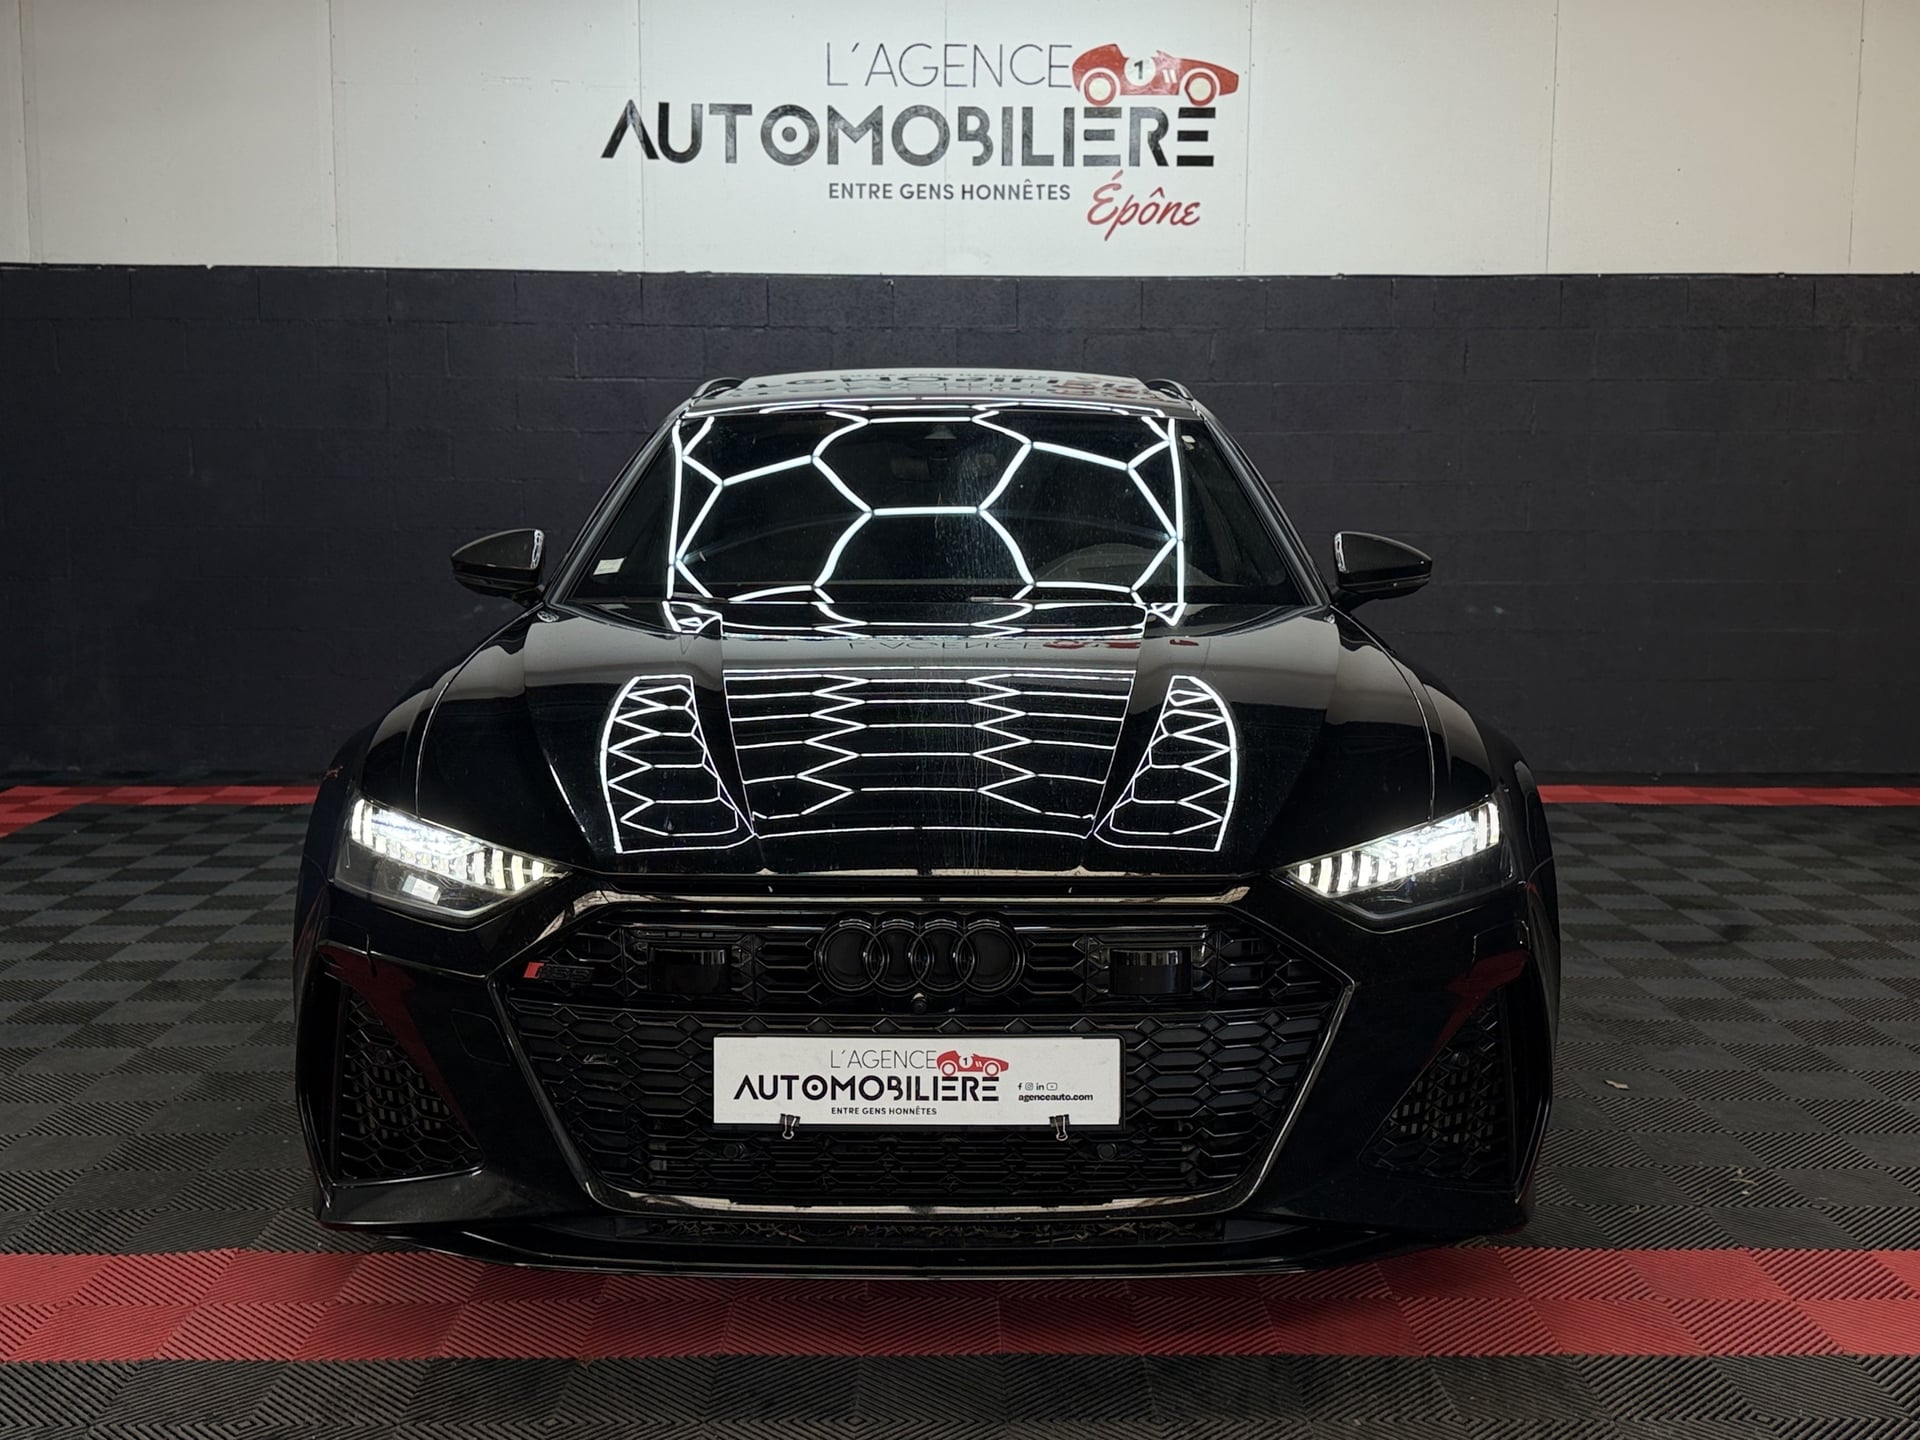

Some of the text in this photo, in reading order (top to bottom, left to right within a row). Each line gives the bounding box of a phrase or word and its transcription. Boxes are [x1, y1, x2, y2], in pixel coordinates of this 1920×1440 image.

[826, 42, 1073, 87] L'AGENCE
[829, 179, 1070, 200] ENTRE GENS HONNÊTES
[1087, 170, 1201, 241] Épône
[830, 1049, 937, 1069] L'AGENCE
[1018, 1093, 1094, 1103] agenceauto.com
[831, 1104, 938, 1116] ENTRE GENS HONNÊTES
